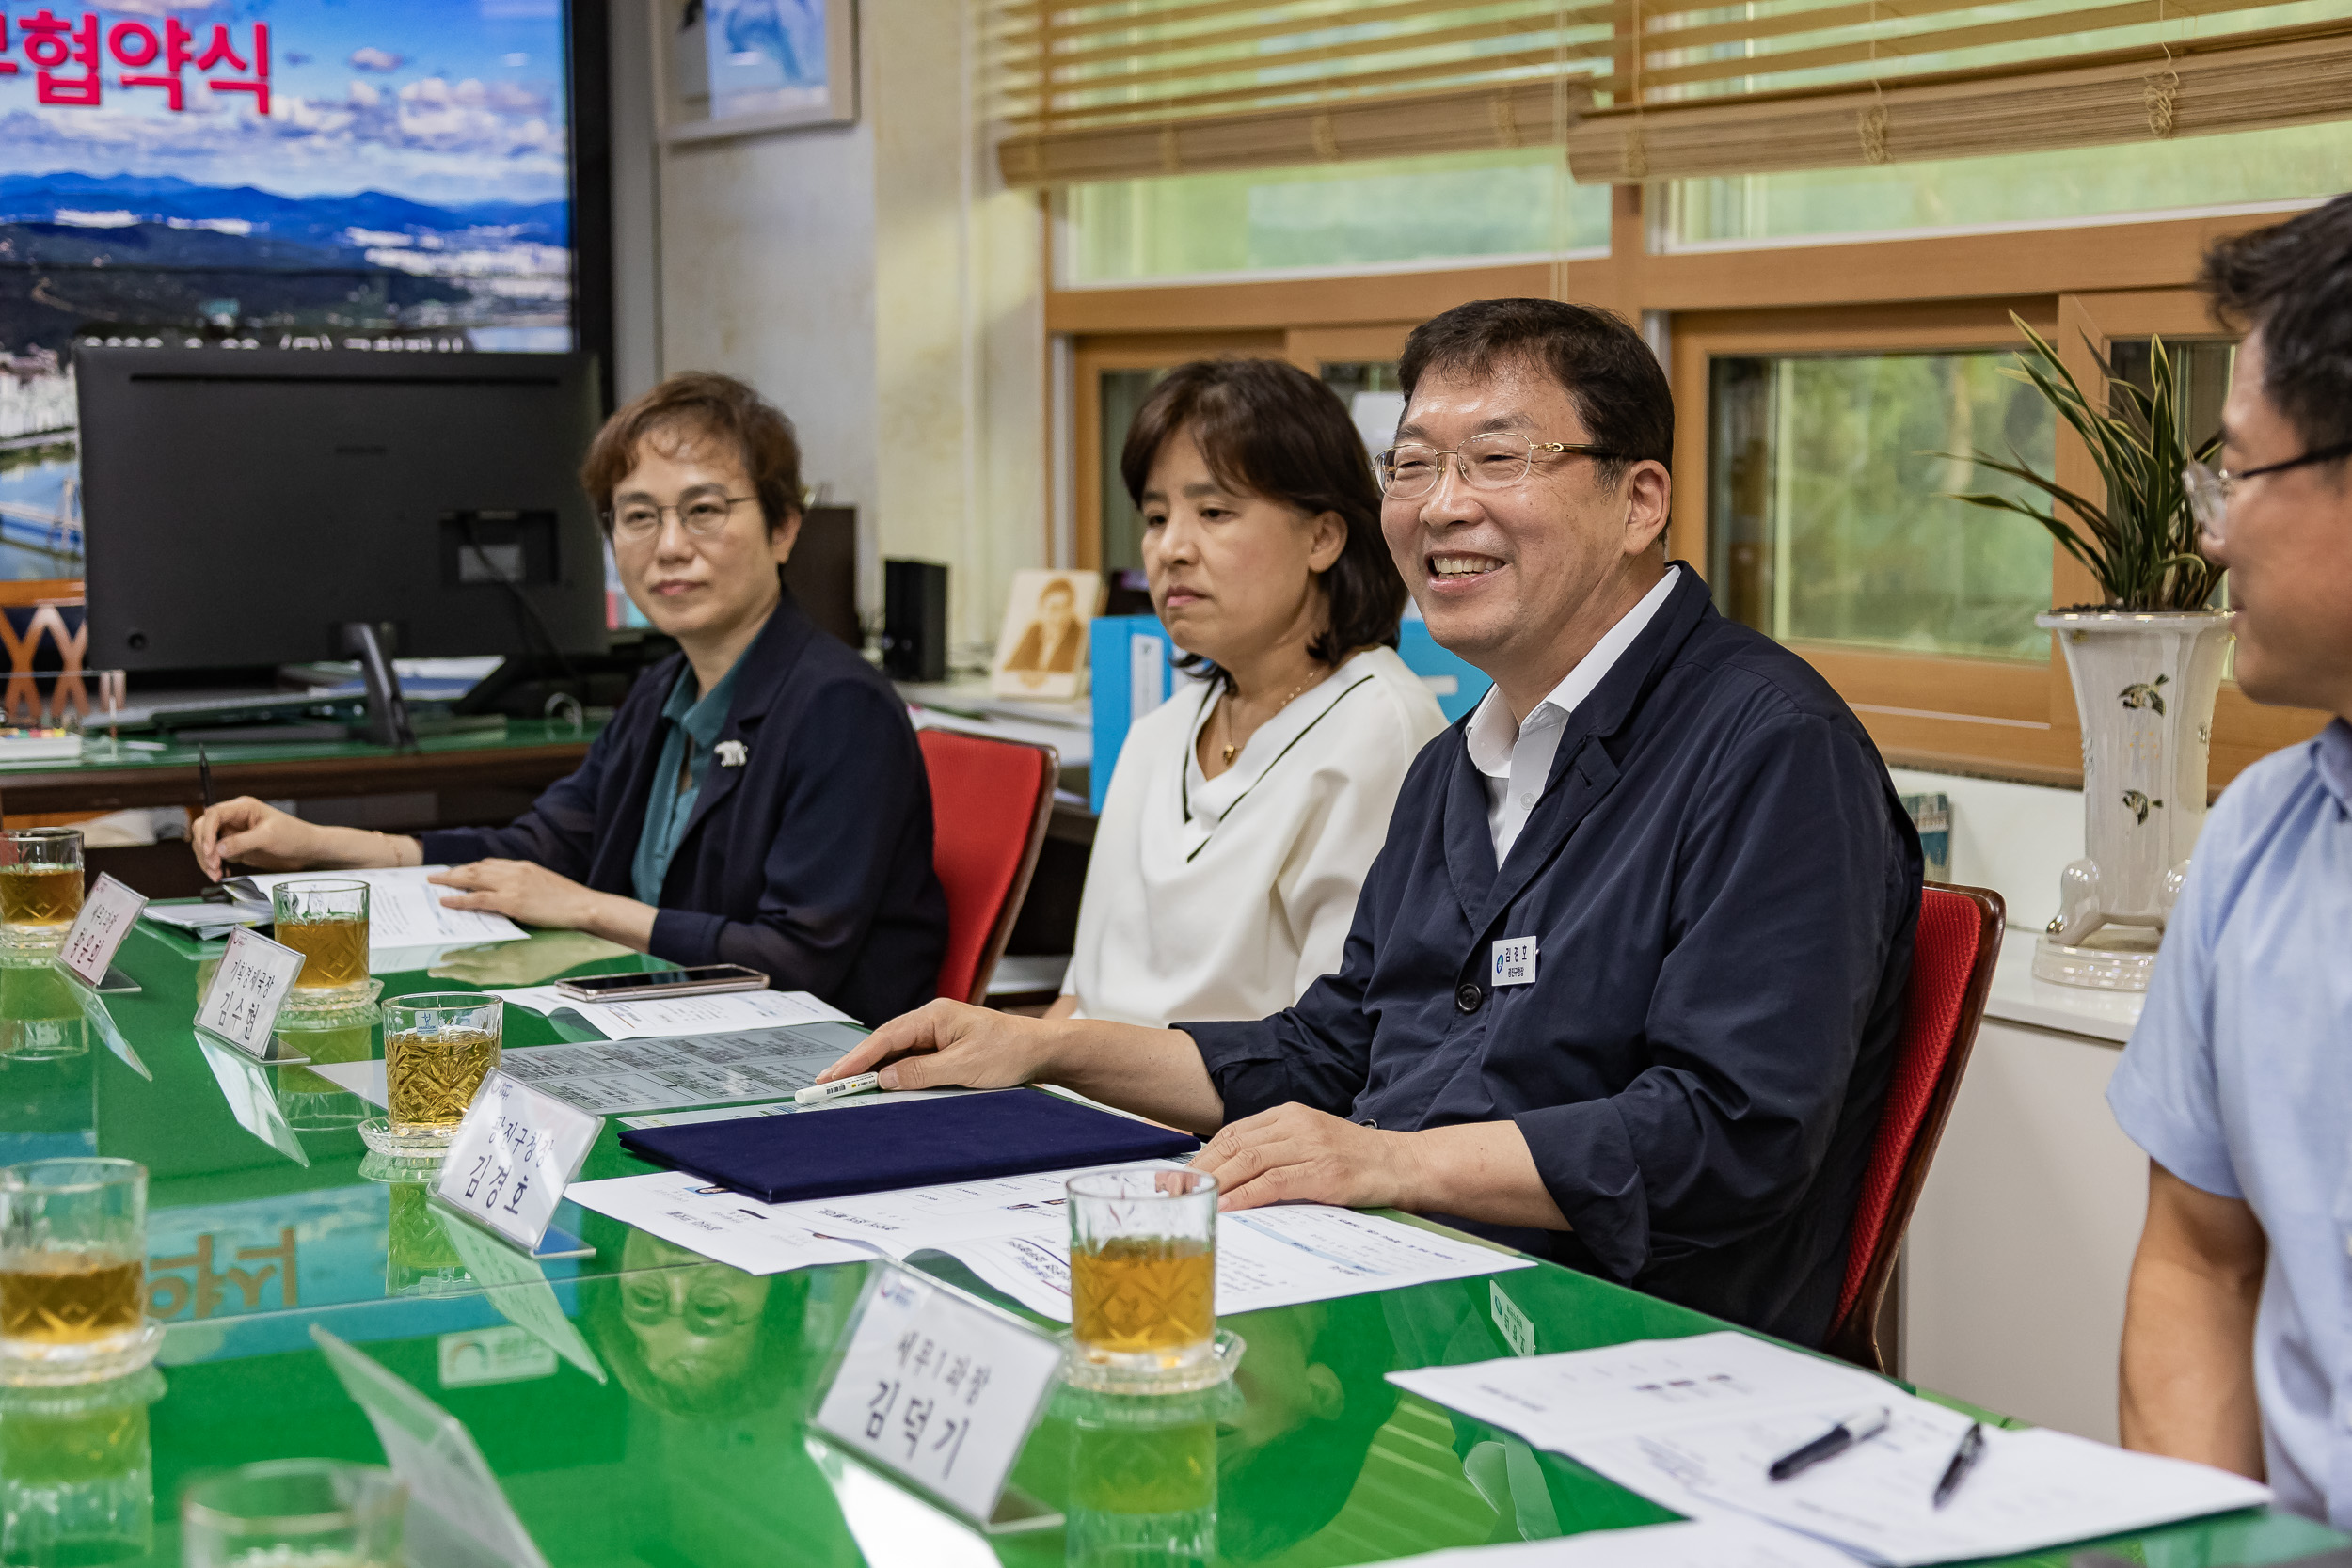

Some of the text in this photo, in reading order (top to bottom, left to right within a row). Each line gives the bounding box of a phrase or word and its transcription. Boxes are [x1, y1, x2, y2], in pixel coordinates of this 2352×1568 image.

[0, 8, 270, 116] 협약식
[230, 958, 277, 999] 기획경제국장
[1505, 944, 1527, 962] 김경호
[217, 990, 261, 1041] 김수현
[488, 1116, 555, 1168] 광진구청장
[464, 1154, 530, 1216] 김경호
[896, 1331, 993, 1407] 세무1과장
[865, 1380, 971, 1481] 김덕기
